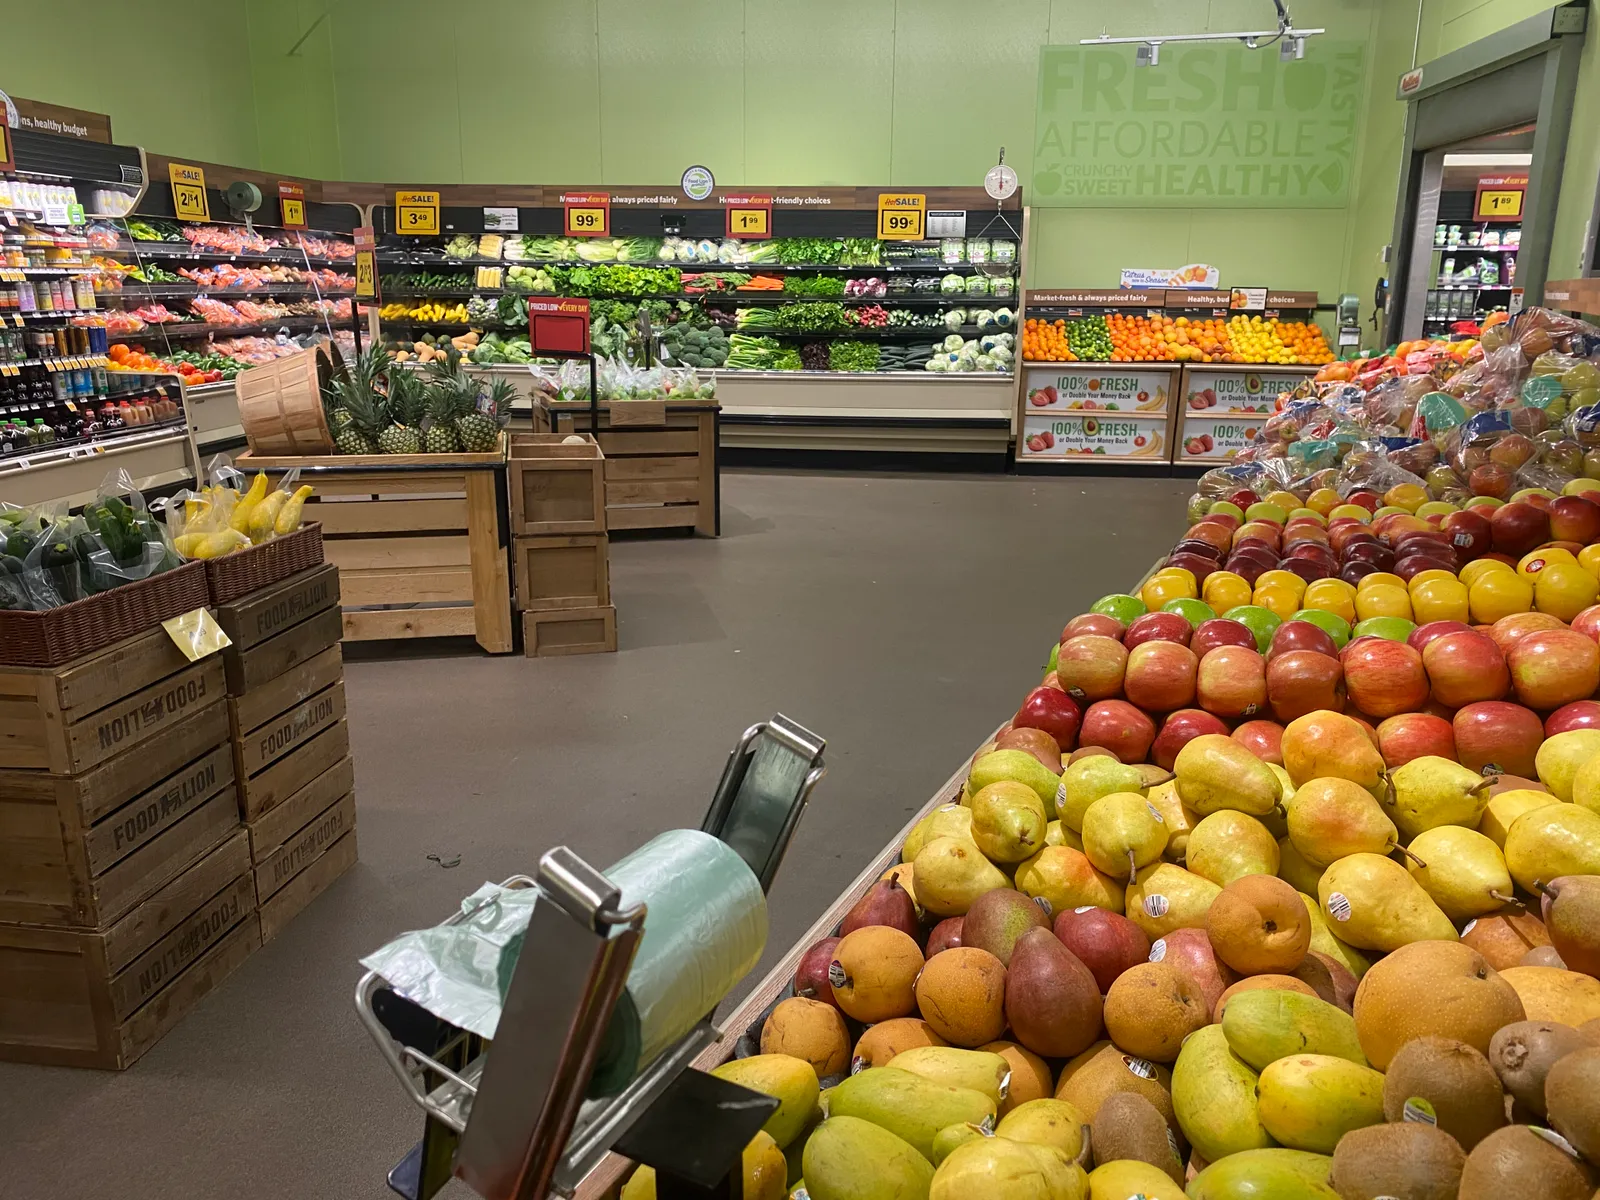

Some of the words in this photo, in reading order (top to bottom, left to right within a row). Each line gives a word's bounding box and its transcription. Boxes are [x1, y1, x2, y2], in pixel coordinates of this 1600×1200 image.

[1041, 50, 1280, 113] FRESH
[1325, 46, 1363, 161] TASTY
[34, 117, 62, 133] healthy
[63, 122, 88, 136] budget
[1036, 120, 1318, 159] AFFORDABLE
[1064, 164, 1133, 177] CRUNCHY
[1064, 179, 1132, 196] SWEET
[1136, 163, 1320, 197] HEALTHY
[412, 195, 434, 203] SALE!
[612, 196, 636, 204] always
[636, 195, 658, 204] priced
[659, 195, 678, 204] fairly
[771, 196, 804, 205] t-friendly
[804, 196, 831, 205] choices
[896, 198, 920, 206] SALE!
[1124, 270, 1145, 278] Citrus
[1145, 276, 1168, 284] Season
[1033, 294, 1077, 302] Market-fresh
[1084, 294, 1107, 302] always
[1107, 294, 1128, 303] priced
[1129, 294, 1148, 302] fairly
[1187, 295, 1216, 304] Healthy,
[1269, 296, 1296, 304] choices
[530, 302, 547, 311] PRICED
[547, 303, 558, 311] LOW
[562, 304, 577, 312] EVERY
[1057, 376, 1088, 391] 100%
[1098, 377, 1139, 392] FRESH
[1213, 379, 1245, 394] 100%
[1100, 392, 1117, 400] Money
[1051, 422, 1082, 436] 100%
[1098, 423, 1138, 437] FRESH
[1213, 425, 1245, 439] 100%
[1097, 437, 1114, 445] Money
[256, 602, 287, 635] FOOD
[303, 581, 328, 608] LION
[166, 675, 207, 714] FOOD
[98, 708, 141, 750] LION
[260, 721, 293, 760] FOOD
[308, 697, 333, 727] LION
[113, 803, 159, 850] FOOD
[181, 763, 216, 801] LION
[316, 811, 343, 846] FOOD
[273, 846, 302, 883] LION
[201, 895, 239, 938] FOOD
[139, 953, 178, 995] LION
